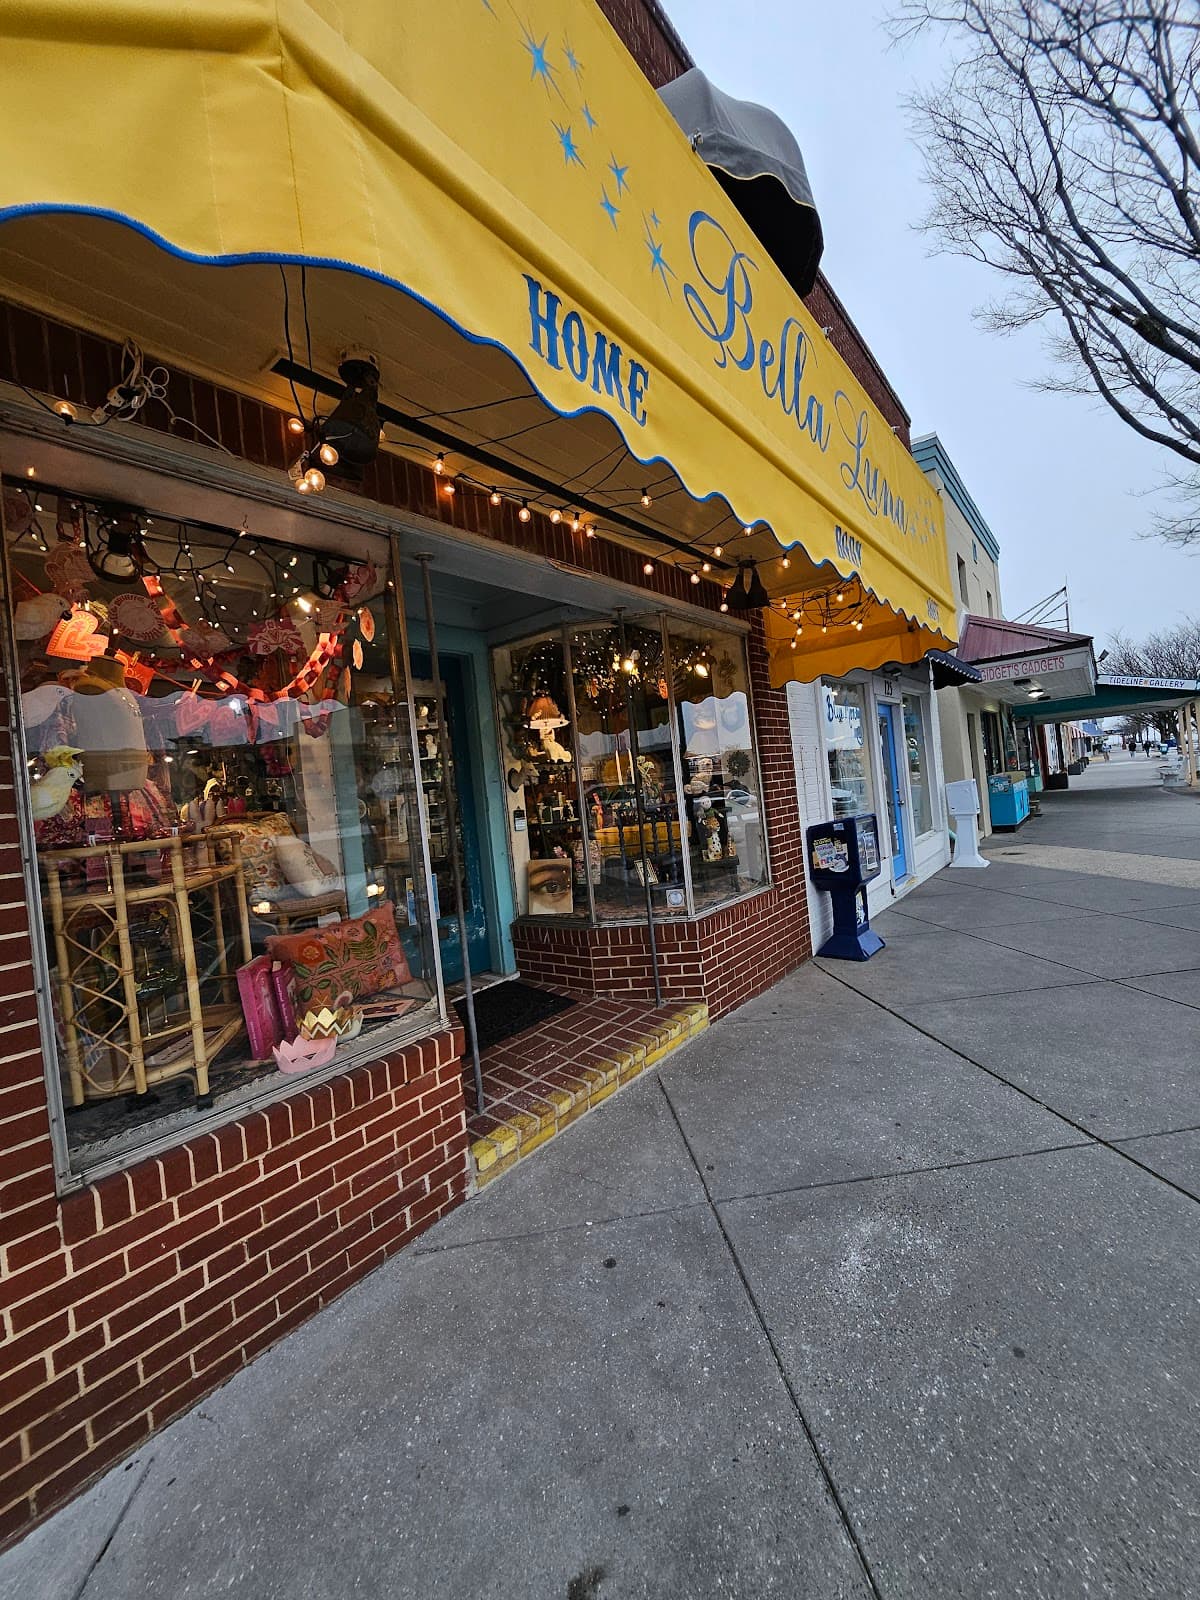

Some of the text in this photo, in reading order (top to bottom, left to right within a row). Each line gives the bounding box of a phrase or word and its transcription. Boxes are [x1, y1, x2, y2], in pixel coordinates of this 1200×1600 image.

[521, 274, 650, 428] HOME
[684, 210, 911, 535] Bella Luna
[980, 656, 1065, 682] GIDGET'S GADGETS
[1109, 676, 1185, 688] TIDELINE GALLERY
[884, 679, 893, 696] 125
